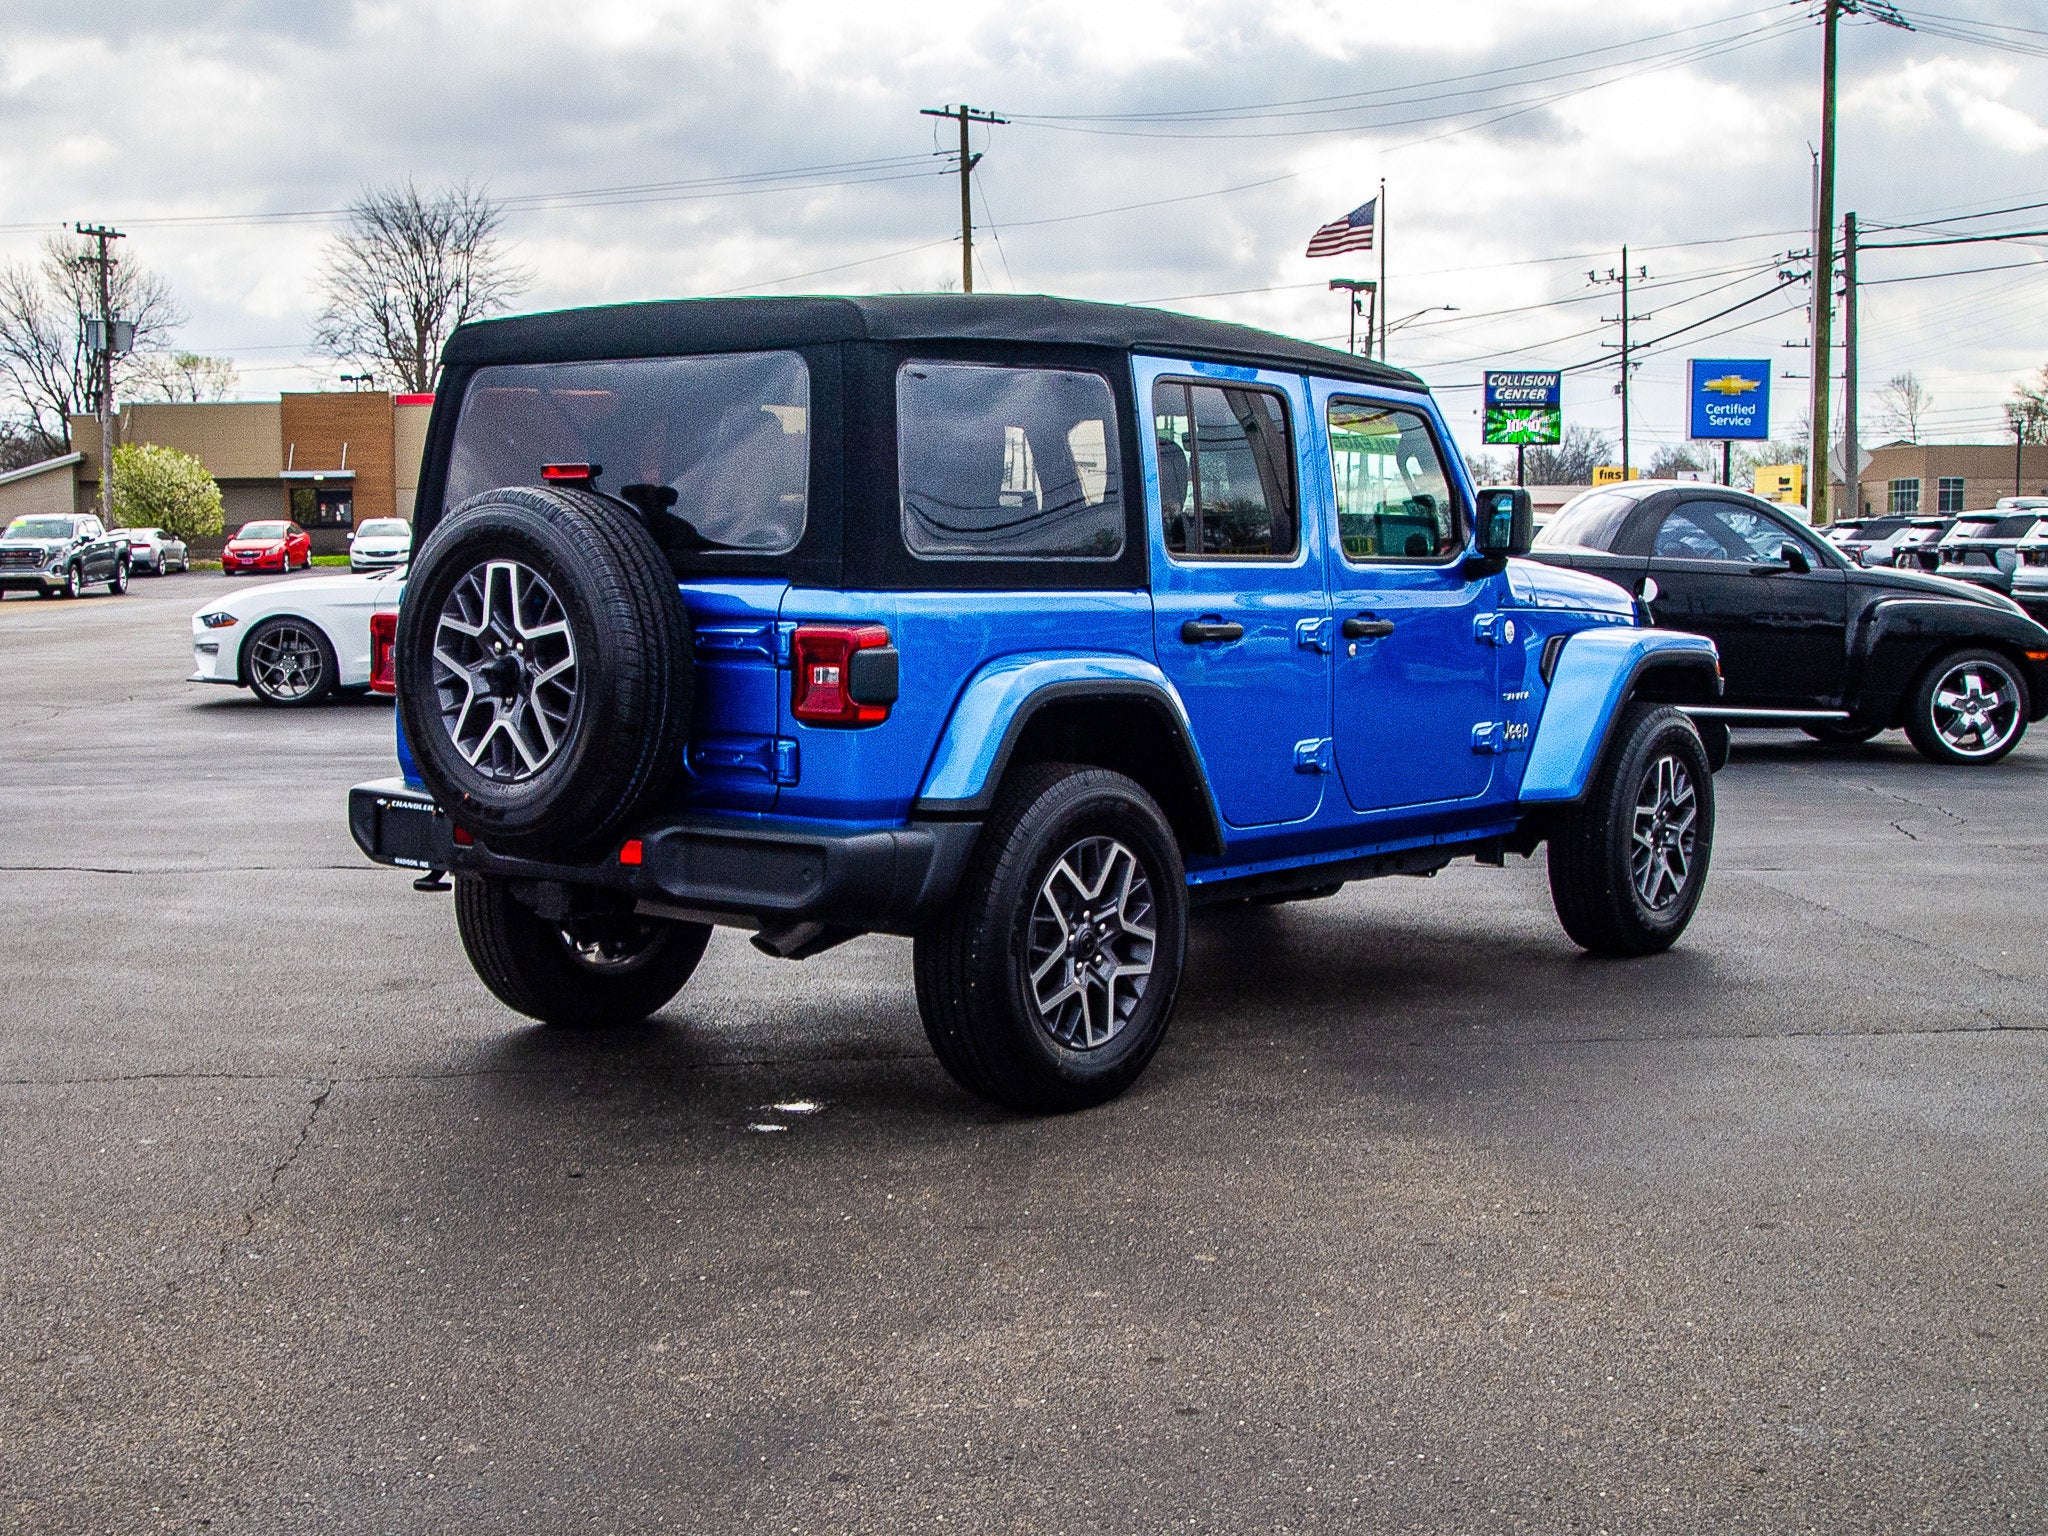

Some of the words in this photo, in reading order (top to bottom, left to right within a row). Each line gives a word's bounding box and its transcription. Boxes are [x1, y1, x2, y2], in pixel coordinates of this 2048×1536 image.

[1488, 374, 1557, 387] COLLISION
[1495, 387, 1547, 400] CENTER
[1705, 403, 1756, 415] Certified
[1709, 414, 1752, 426] Service
[1503, 720, 1529, 742] Jeep
[391, 800, 435, 811] CHANDLER
